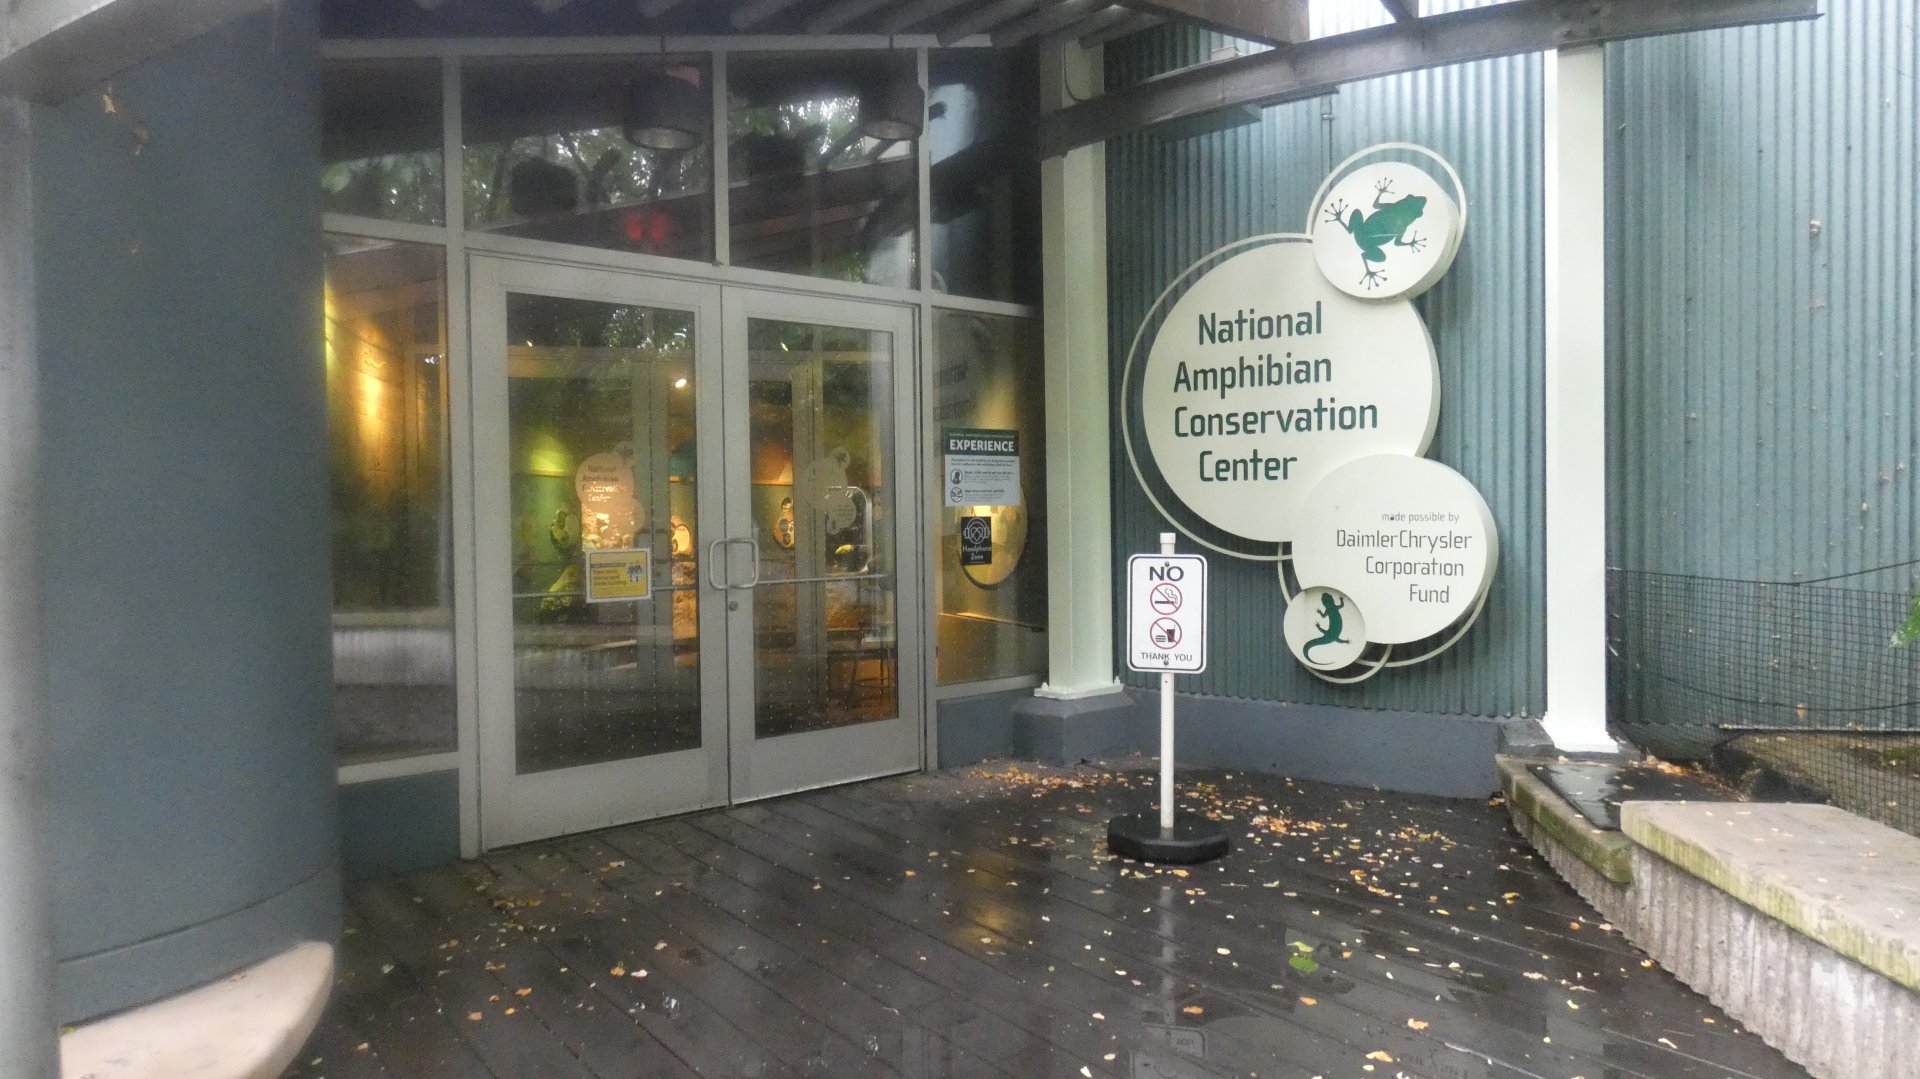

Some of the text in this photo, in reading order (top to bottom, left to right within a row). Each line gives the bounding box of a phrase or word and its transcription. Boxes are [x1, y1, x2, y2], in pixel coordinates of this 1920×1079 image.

[1199, 301, 1321, 345] National
[1174, 352, 1332, 399] Amphibian
[1174, 397, 1378, 437] Conservation
[950, 440, 1014, 451] EXPERIENCE
[1200, 449, 1297, 481] Center
[1382, 512, 1459, 523] made possible by
[1336, 529, 1472, 554] DaimlerChrysler
[1149, 565, 1185, 582] NO
[1366, 556, 1464, 580] Corporation
[1409, 583, 1450, 603] Fund
[1141, 652, 1193, 662] THANK YOU
